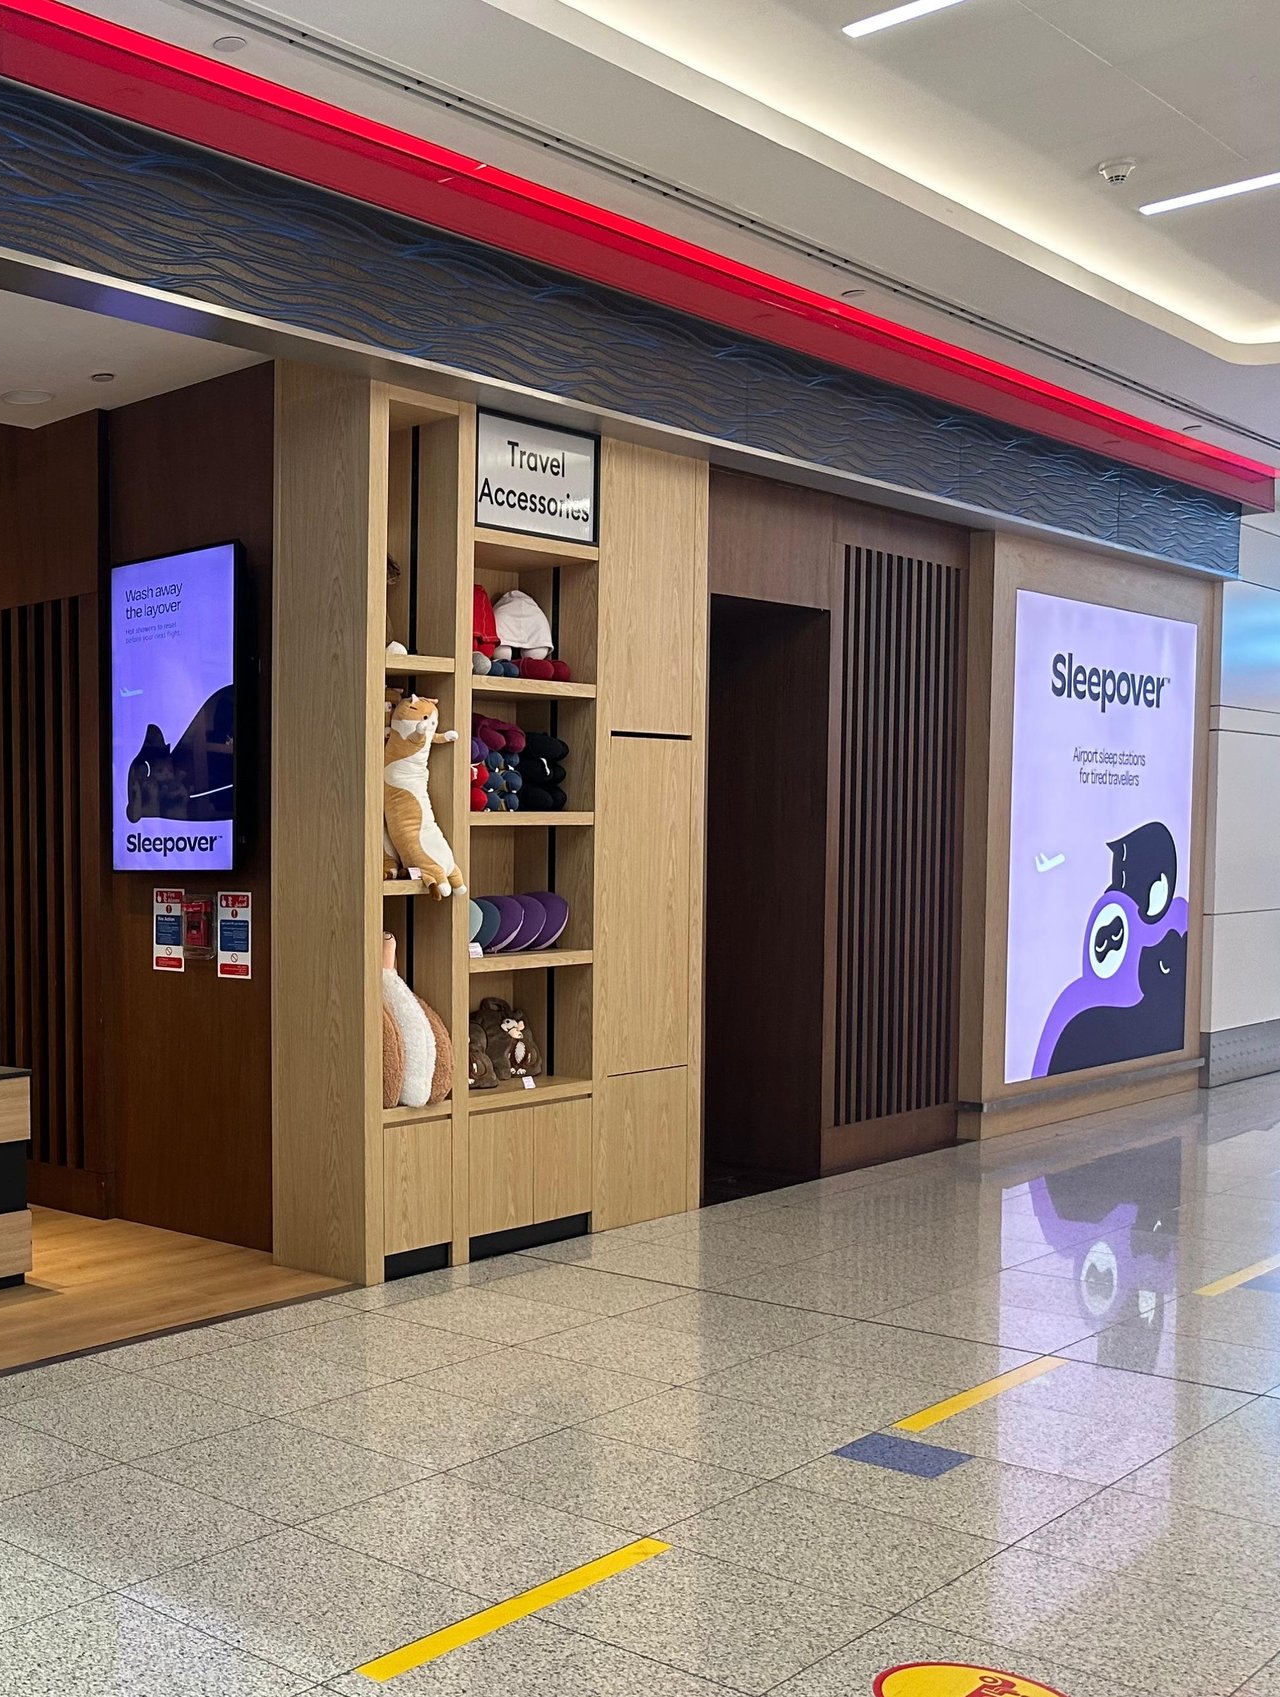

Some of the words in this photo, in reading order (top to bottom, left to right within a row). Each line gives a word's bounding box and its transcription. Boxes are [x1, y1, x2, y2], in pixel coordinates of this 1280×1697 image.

[507, 440, 565, 478] Travel
[478, 477, 590, 522] Accessories
[125, 586, 154, 603] Wash
[155, 582, 183, 597] away
[125, 605, 143, 620] the
[144, 600, 182, 619] layover
[1073, 746, 1099, 766] Airport
[1099, 748, 1117, 766] sleep
[1118, 749, 1146, 767] stations
[1079, 767, 1090, 784] for
[1091, 769, 1107, 785] tired
[1108, 770, 1140, 787] travellers
